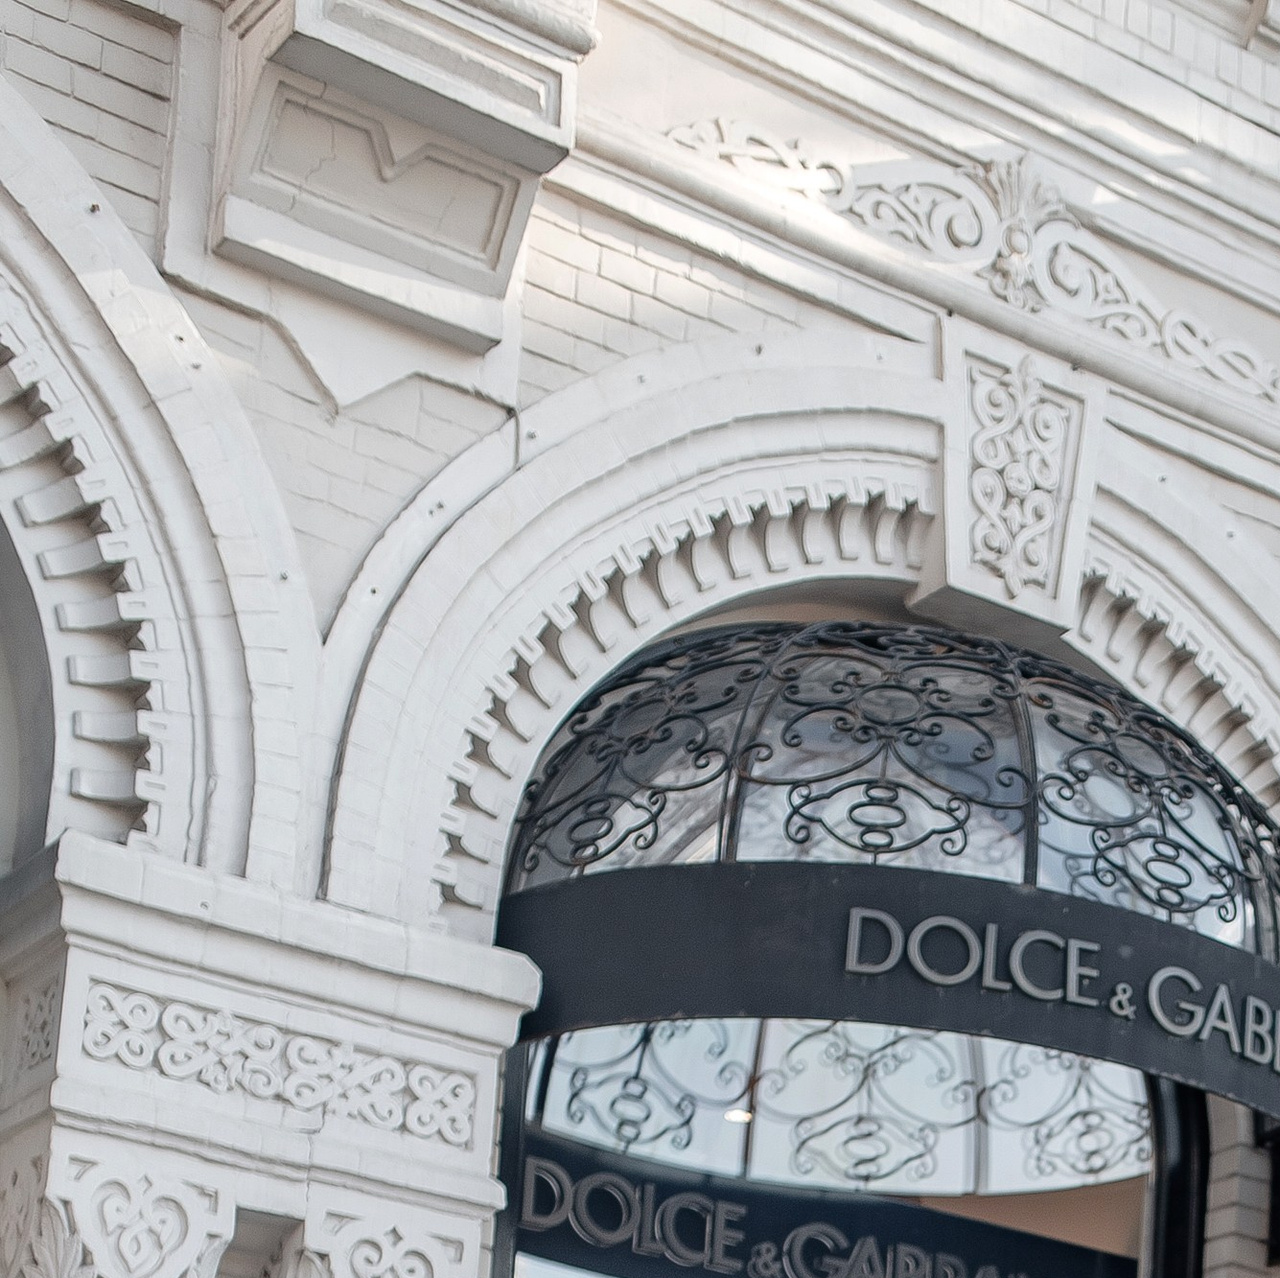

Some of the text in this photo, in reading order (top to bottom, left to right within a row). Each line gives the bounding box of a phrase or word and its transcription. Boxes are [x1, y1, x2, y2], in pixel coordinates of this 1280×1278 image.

[845, 906, 1101, 1007] DOLCE
[1109, 982, 1137, 1020] &
[519, 1155, 748, 1276] DOLCE
